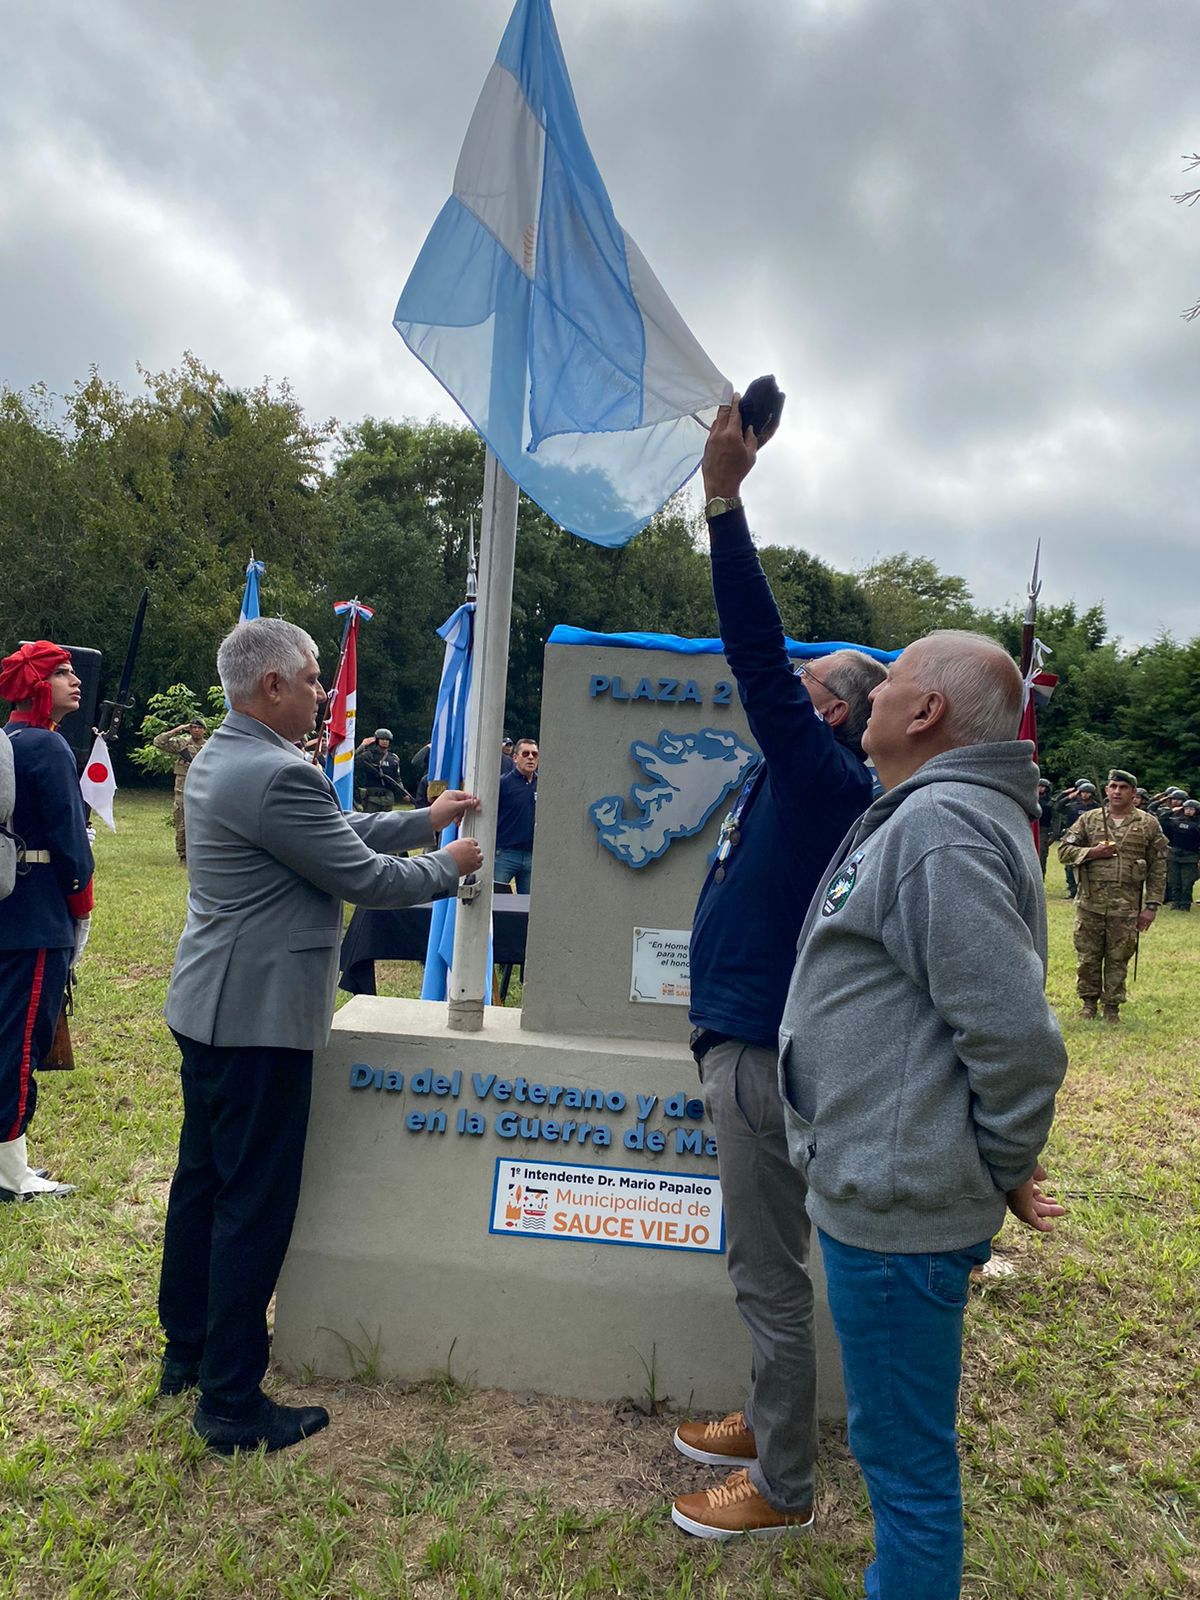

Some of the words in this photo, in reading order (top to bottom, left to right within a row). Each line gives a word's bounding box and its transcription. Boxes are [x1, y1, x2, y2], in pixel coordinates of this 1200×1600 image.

[590, 674, 702, 704] PLAZA
[712, 680, 733, 705] 2
[656, 951, 675, 959] para
[410, 1068, 462, 1097] del
[471, 1072, 627, 1112] Veterano
[637, 1093, 658, 1121] y
[405, 1109, 448, 1134] en
[457, 1108, 486, 1136] la
[495, 1111, 612, 1147] Guerra
[623, 1122, 666, 1153] de
[524, 1168, 595, 1185] Intendente
[597, 1175, 616, 1187] Dr.
[619, 1177, 656, 1190] Mario
[659, 1181, 712, 1195] Papaleo
[556, 1188, 682, 1215] Municipalidad
[687, 1200, 711, 1217] de
[552, 1211, 634, 1238] SAUCE
[639, 1219, 710, 1245] VIEJO
